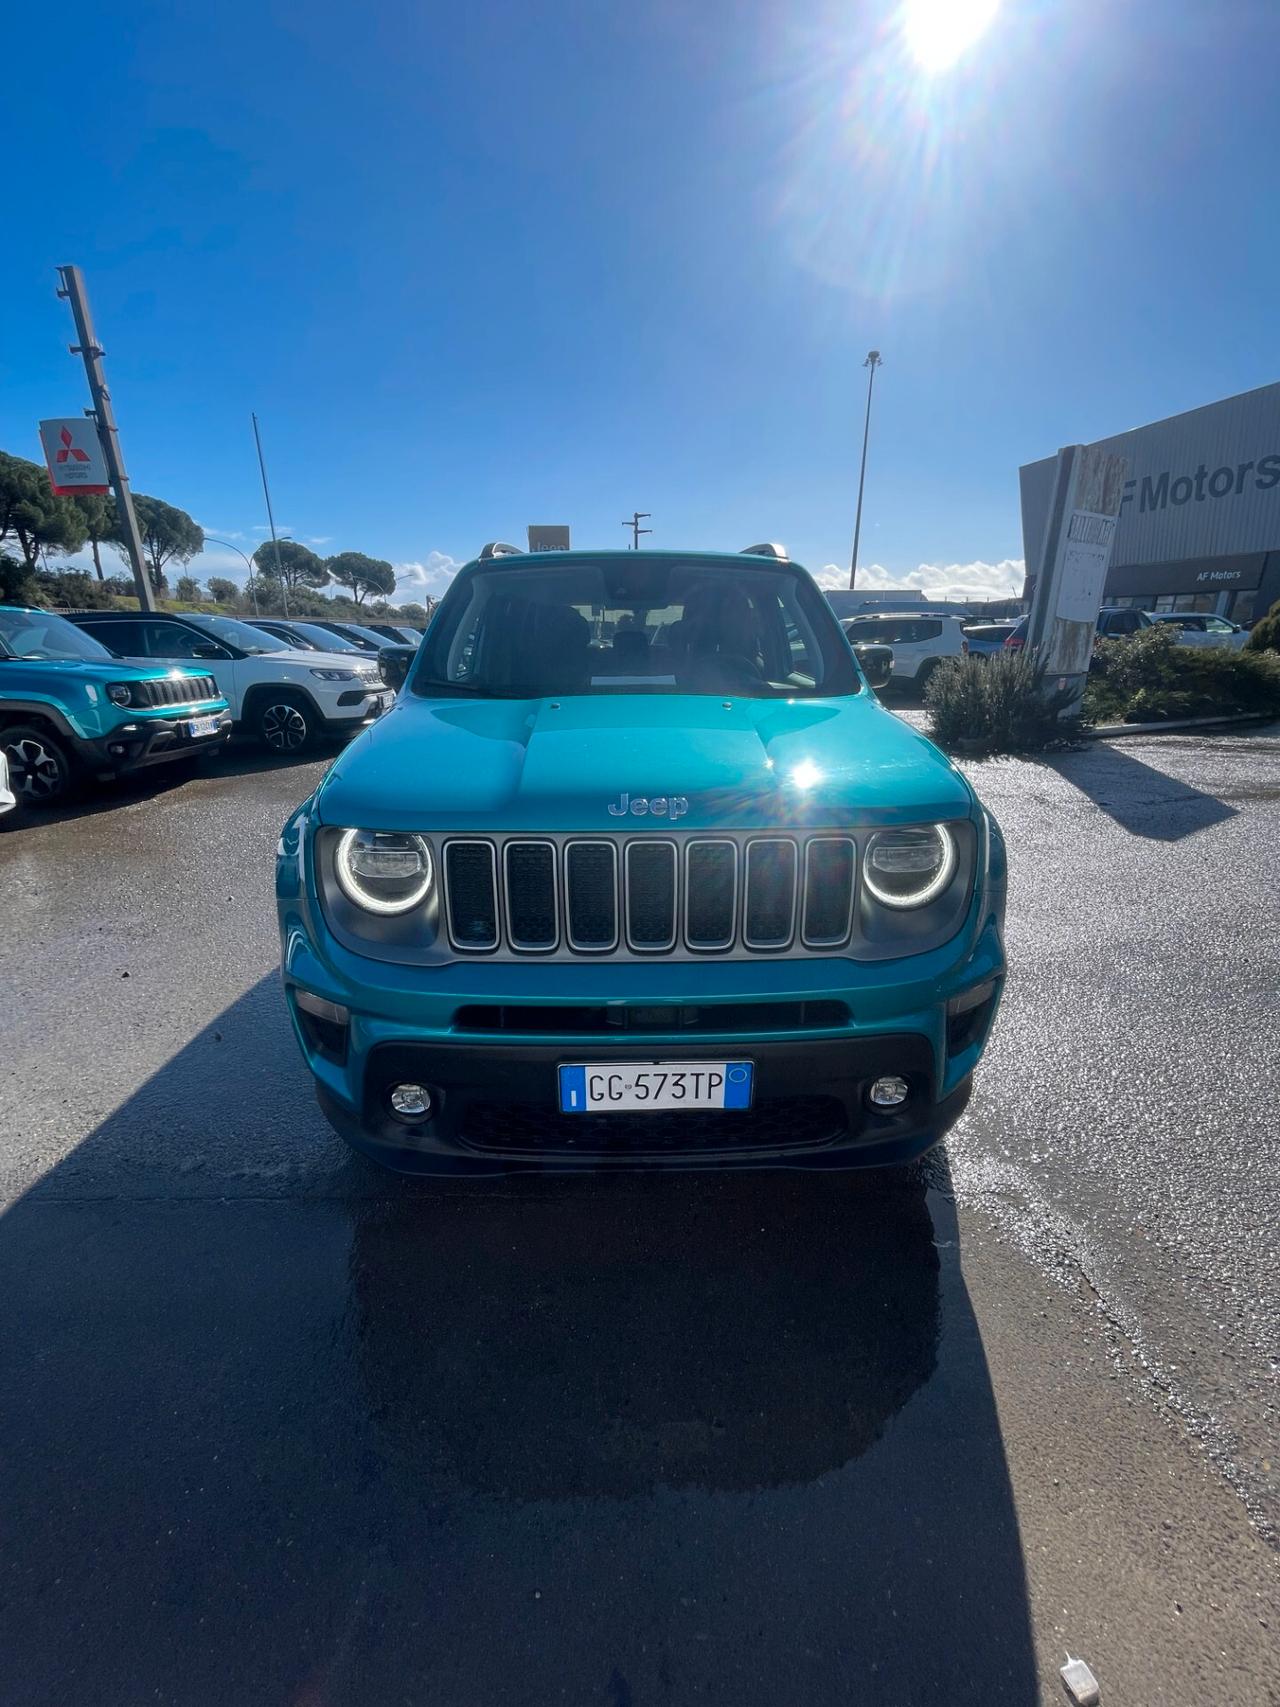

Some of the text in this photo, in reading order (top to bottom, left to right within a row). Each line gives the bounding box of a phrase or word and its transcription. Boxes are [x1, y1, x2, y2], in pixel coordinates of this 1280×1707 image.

[1139, 455, 1280, 513] Motors
[1196, 571, 1241, 581] AF Motors
[607, 793, 689, 820] Jeep
